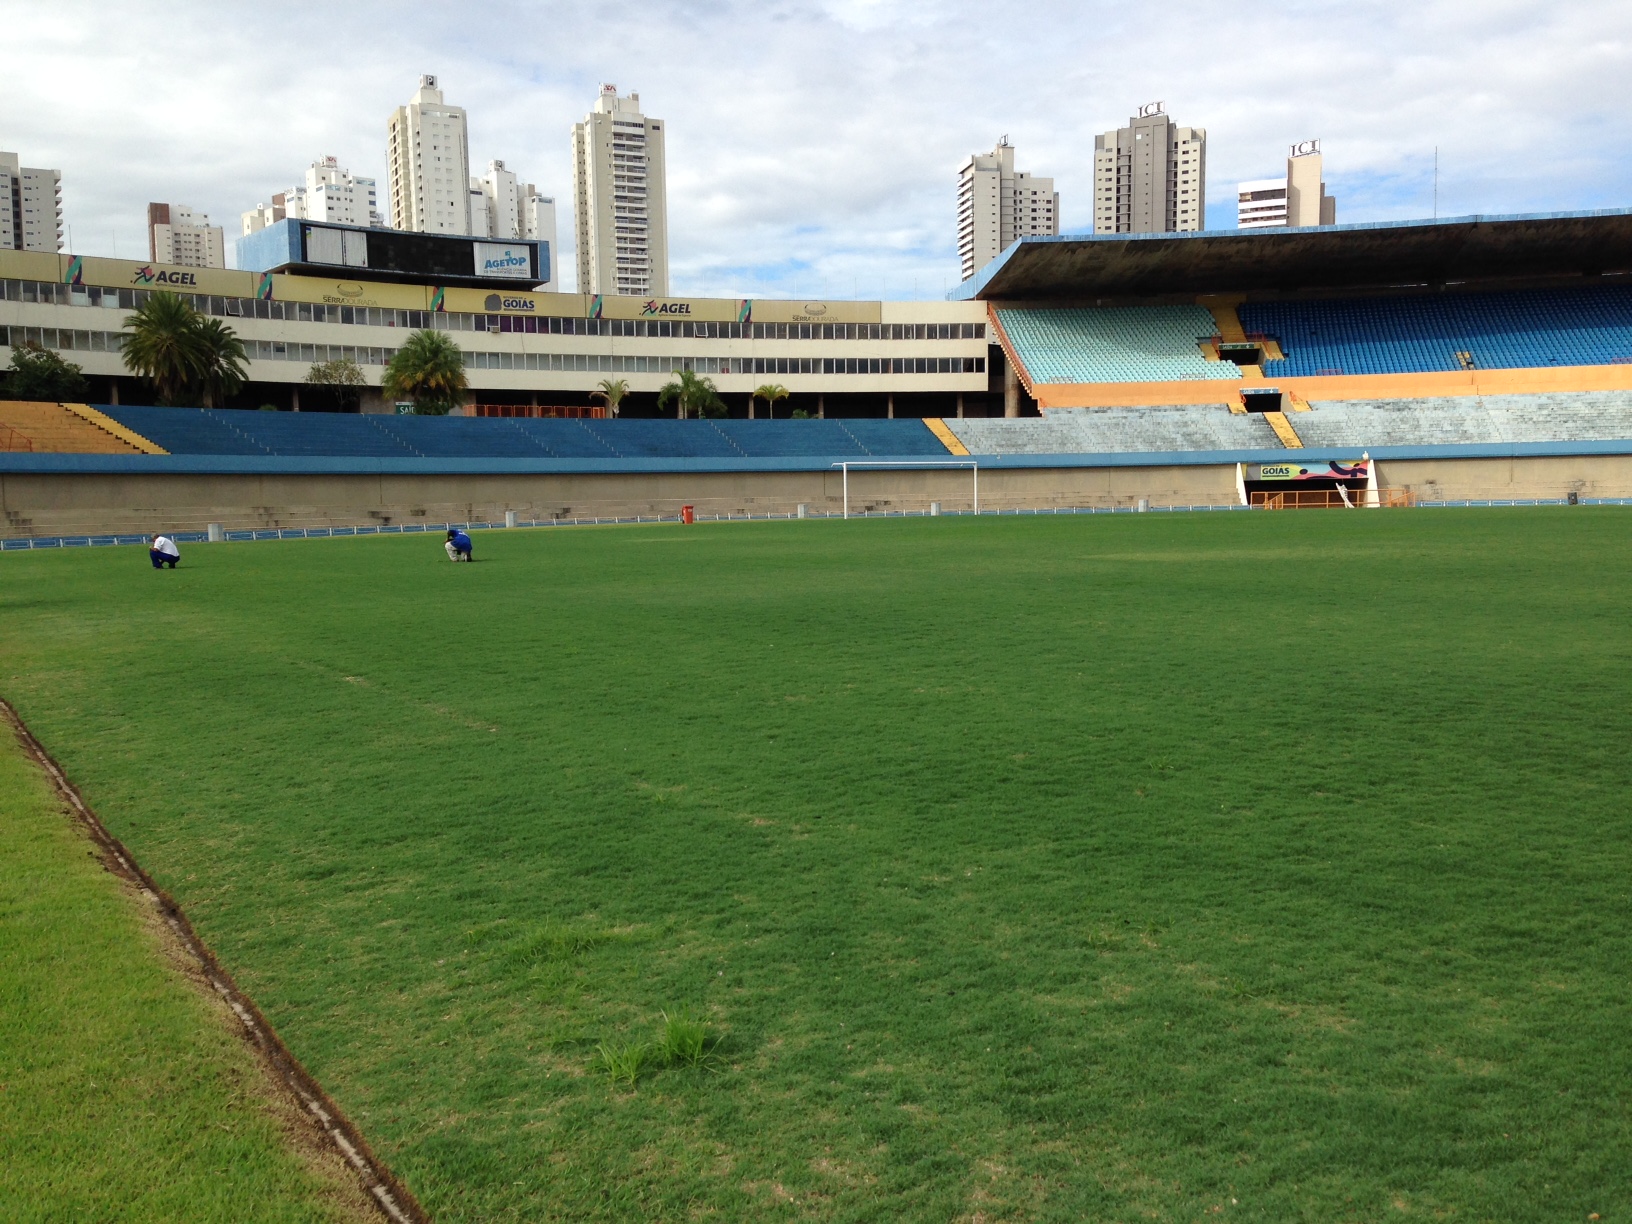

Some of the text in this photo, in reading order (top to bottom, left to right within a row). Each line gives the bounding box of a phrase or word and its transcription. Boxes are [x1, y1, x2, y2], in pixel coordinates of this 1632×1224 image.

[485, 256, 527, 269] AGETOP
[155, 270, 197, 286] AGEL
[503, 297, 535, 309] GOIÁS
[659, 302, 691, 314] AGEL
[1262, 465, 1290, 475] GOIÁS
